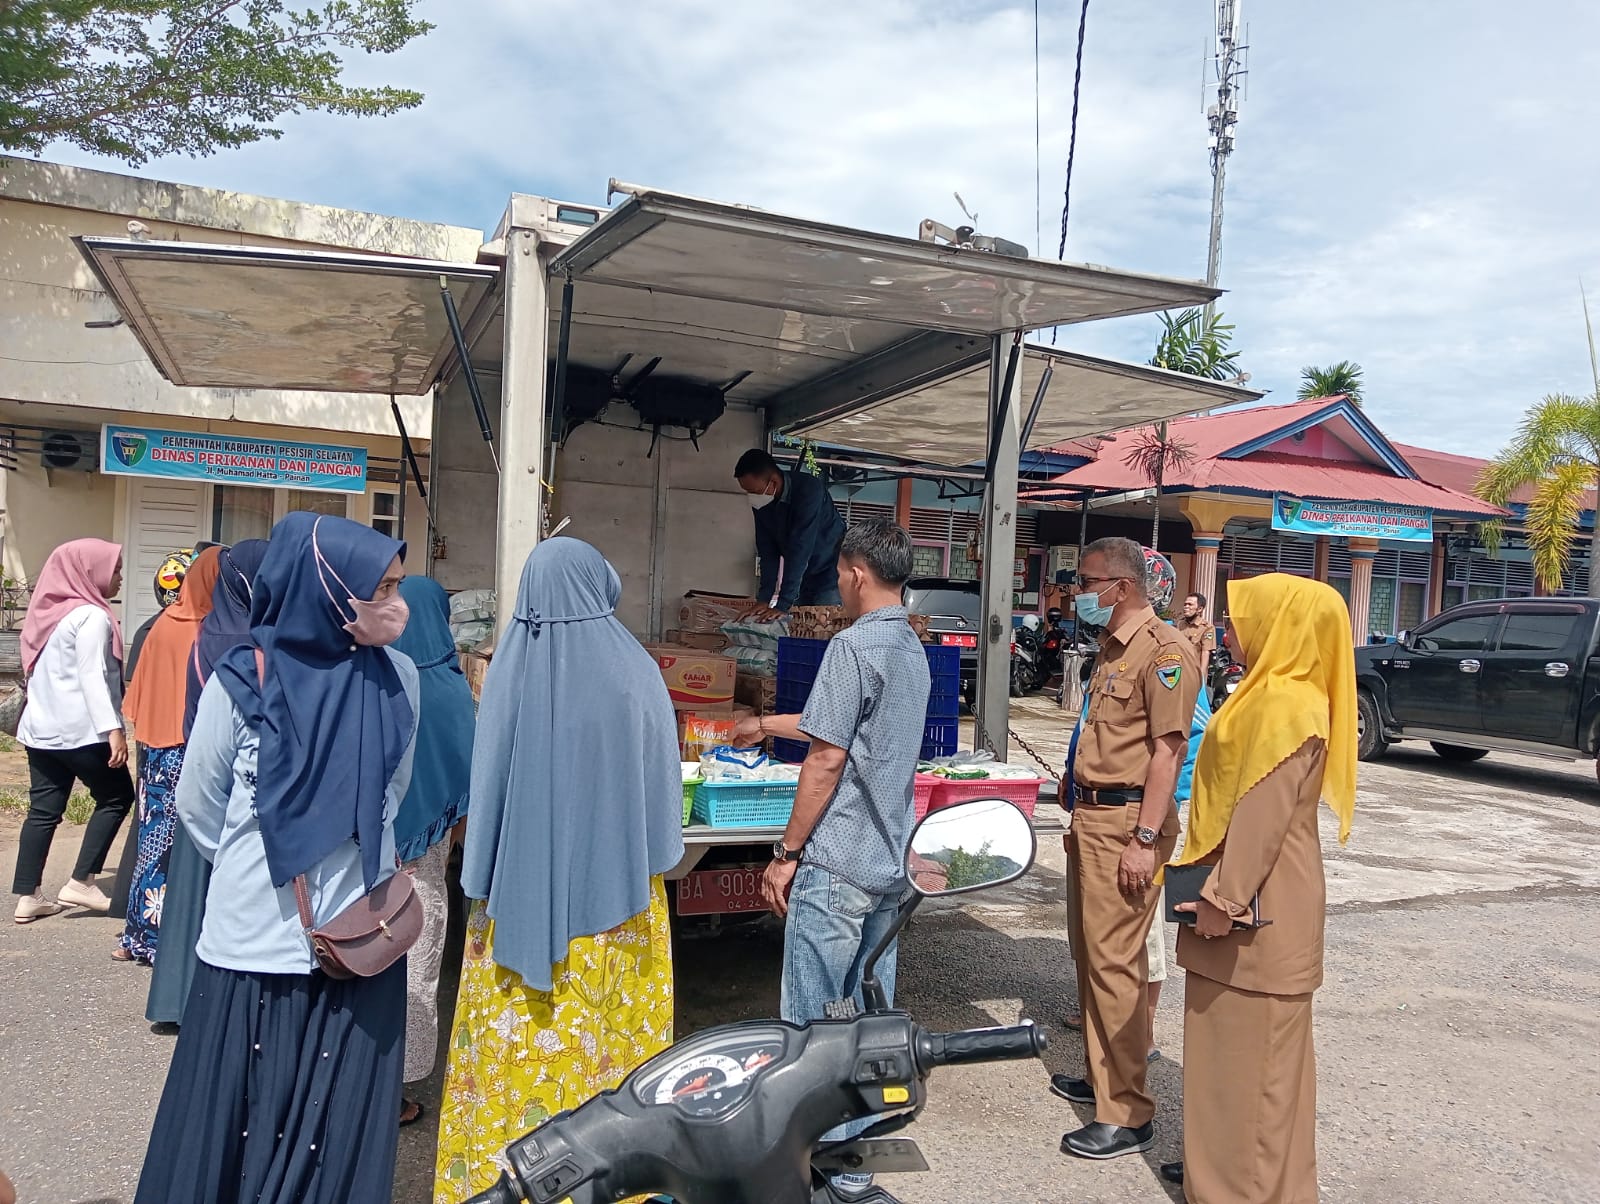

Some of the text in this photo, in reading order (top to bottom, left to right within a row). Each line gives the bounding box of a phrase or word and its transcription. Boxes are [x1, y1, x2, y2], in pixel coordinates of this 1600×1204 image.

[162, 436, 221, 450] PEMERINTAH
[224, 441, 276, 455] KABUPATEN
[280, 447, 313, 459] PESISIR
[316, 449, 353, 462] SELATAN
[151, 448, 362, 477] DINAS PERIKANAN DAN PANGAN
[217, 467, 254, 478] Muhamad
[256, 471, 278, 479] Hatta
[284, 473, 310, 482] Painan
[1301, 510, 1429, 529] DINAS PERIKANAN DAN PANGAN
[683, 673, 712, 682] CAMAR
[680, 875, 704, 900] BA
